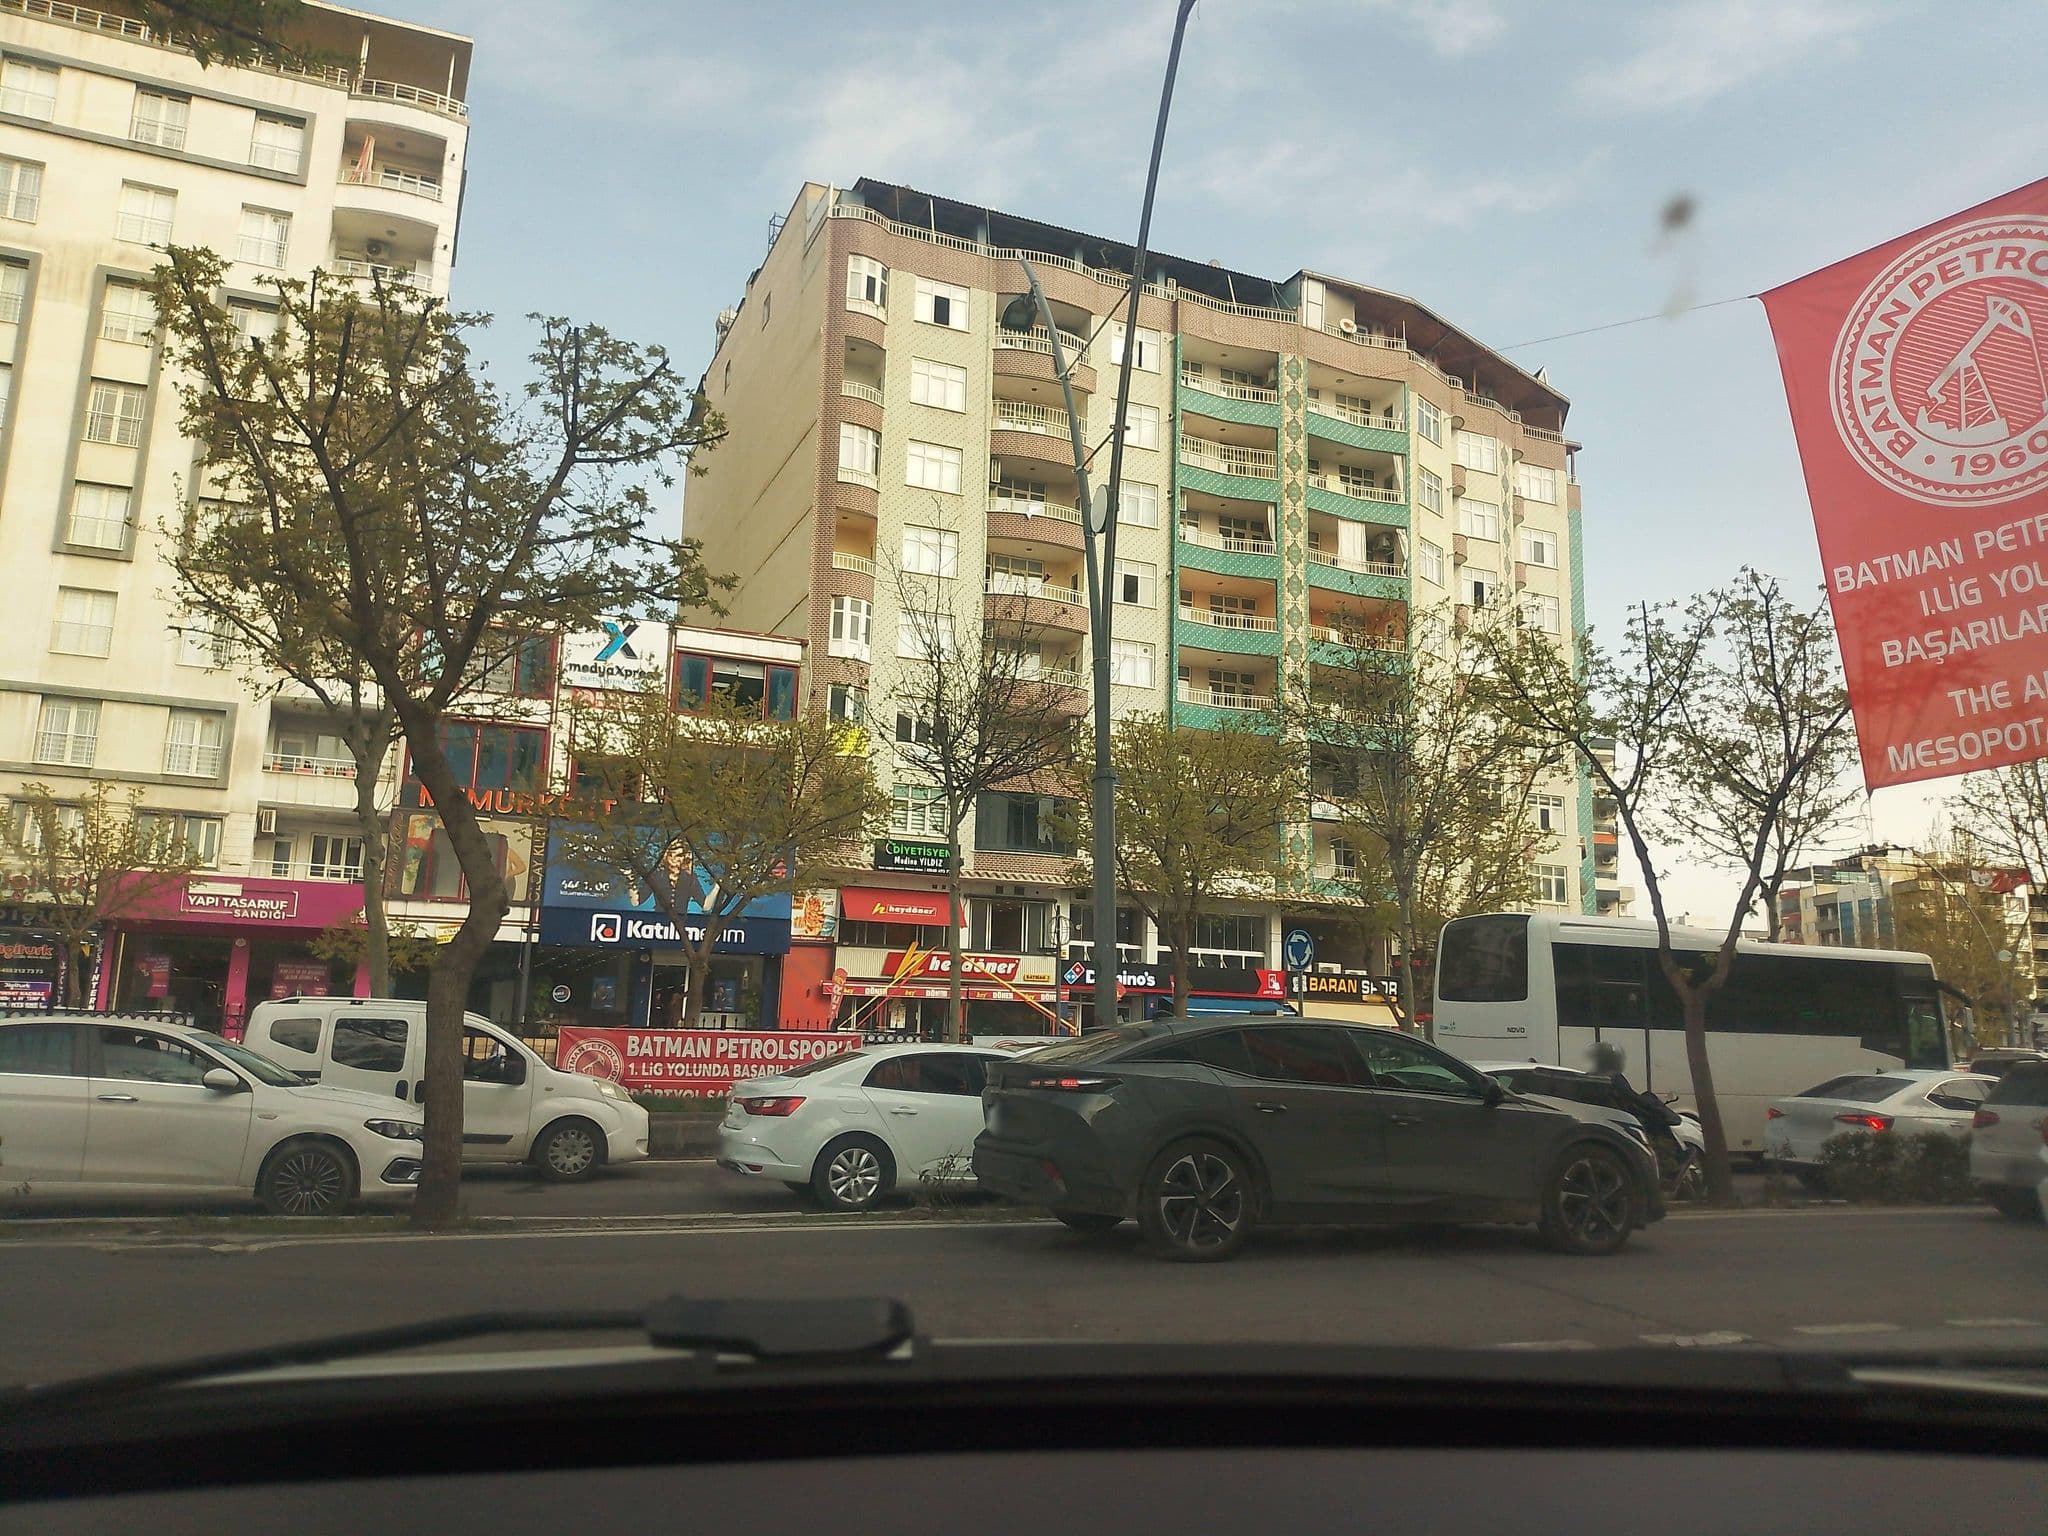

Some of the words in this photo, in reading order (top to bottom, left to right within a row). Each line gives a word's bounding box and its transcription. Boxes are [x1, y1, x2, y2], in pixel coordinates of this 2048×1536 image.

[1860, 297, 1918, 459] BATMAN
[1833, 537, 1965, 593] BATMAN
[568, 662, 661, 679] medyaXpre
[1947, 680, 2012, 718] THE
[2023, 670, 2048, 704] A
[1887, 717, 2048, 773] MESOPOT
[188, 895, 219, 907] YAPI
[222, 897, 289, 910] TASARRUF
[233, 908, 286, 920] SANDIĞI
[929, 955, 1016, 974] hedöner
[1086, 969, 1156, 987] Dino's
[1309, 976, 1358, 994] BARAN
[626, 1035, 712, 1058] BATMAN
[628, 1062, 638, 1076] 1.
[667, 1062, 730, 1077] YOLUNDA
